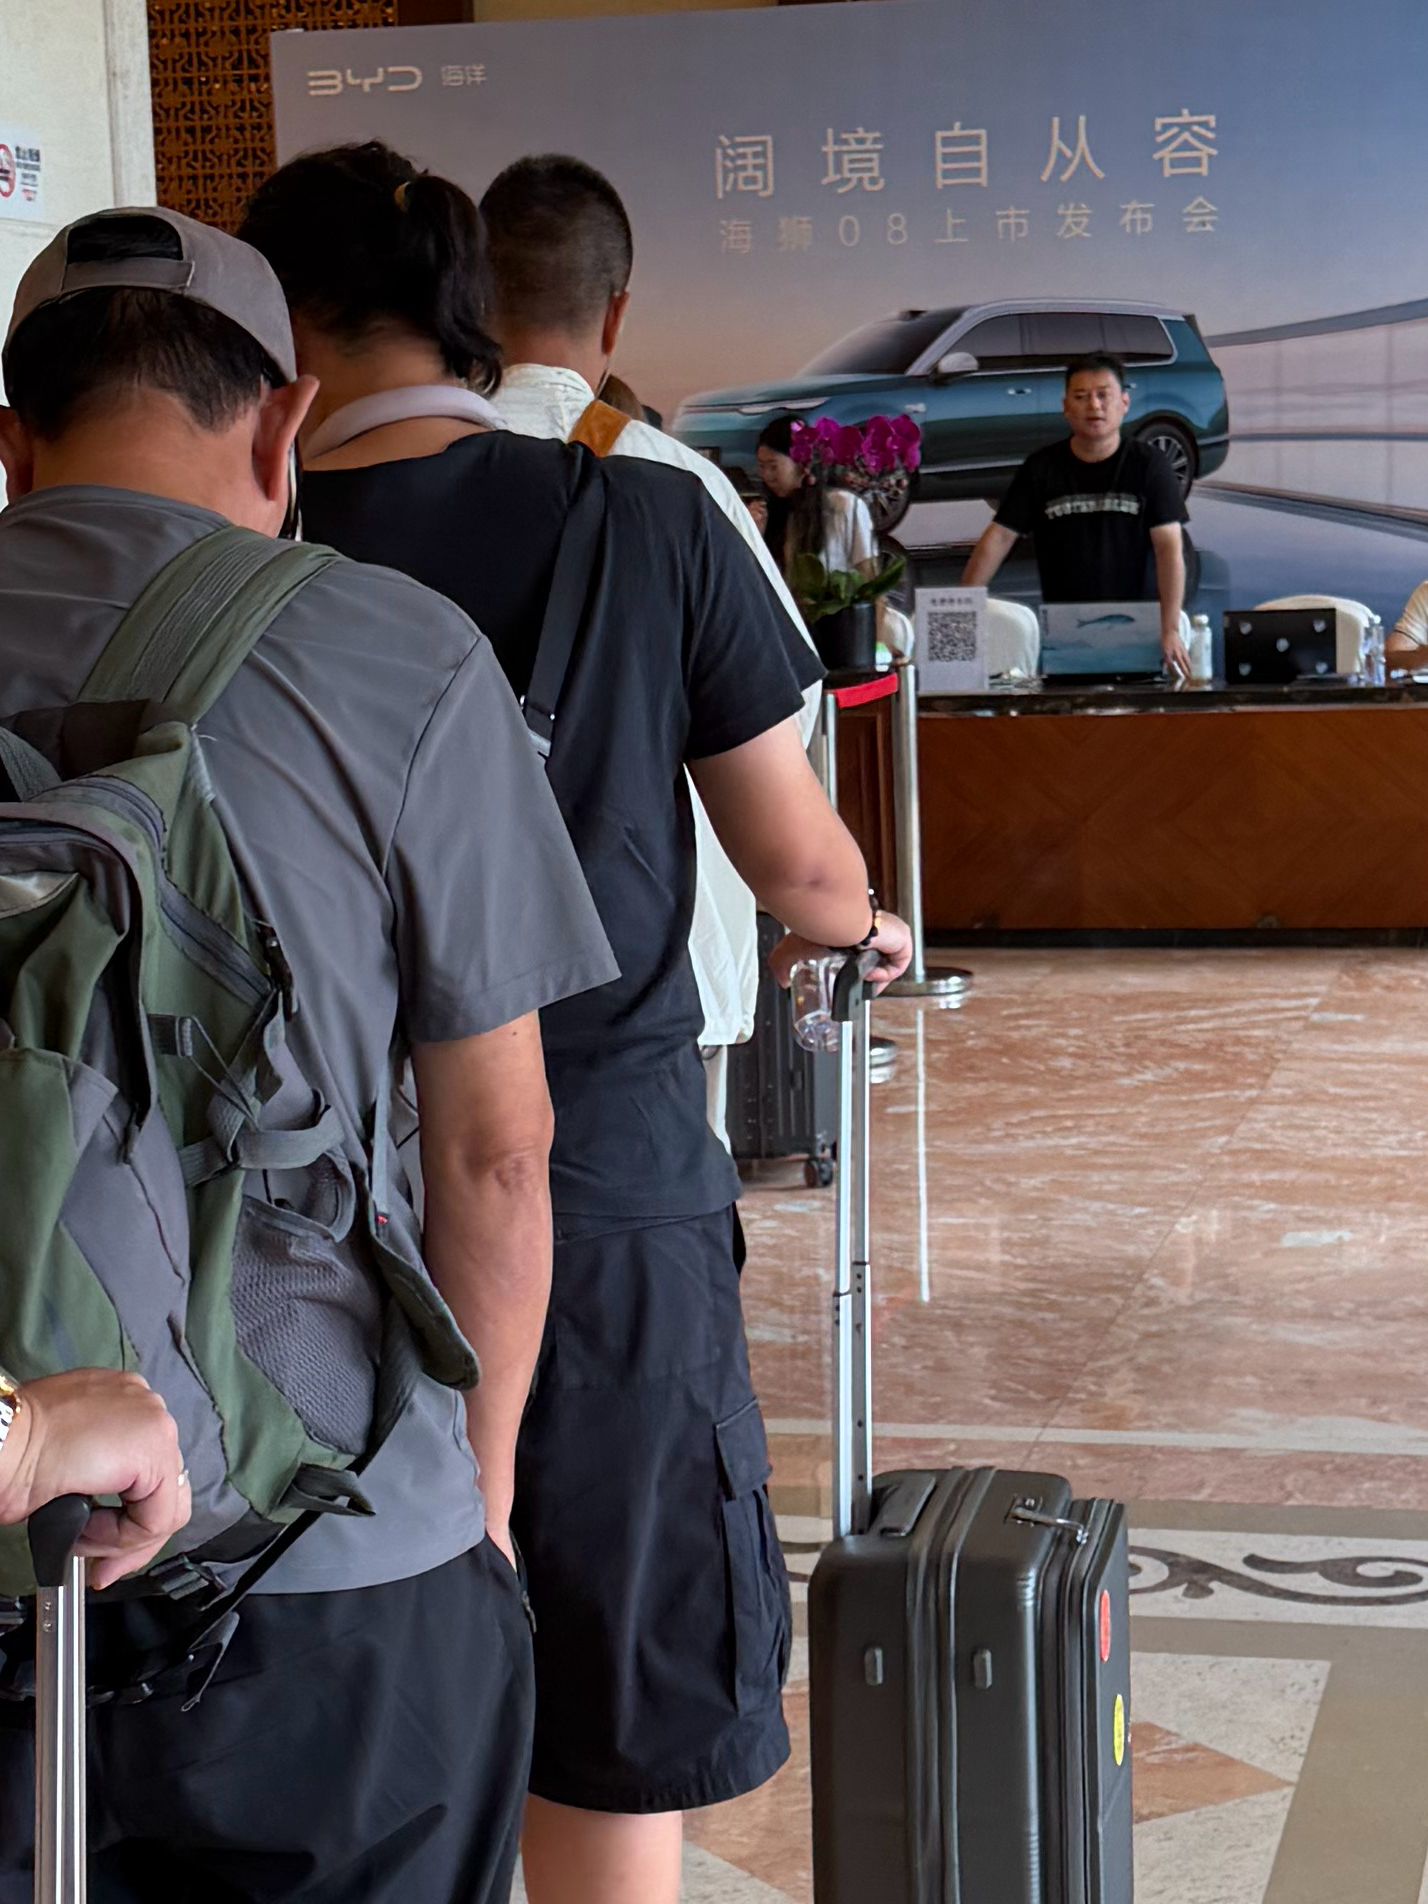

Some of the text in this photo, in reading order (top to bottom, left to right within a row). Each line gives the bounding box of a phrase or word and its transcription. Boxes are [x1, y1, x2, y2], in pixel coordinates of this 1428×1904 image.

[307, 65, 422, 96] BYD
[714, 108, 1218, 199] 阔境自从容
[719, 195, 1219, 254] 海狮08上市发布会
